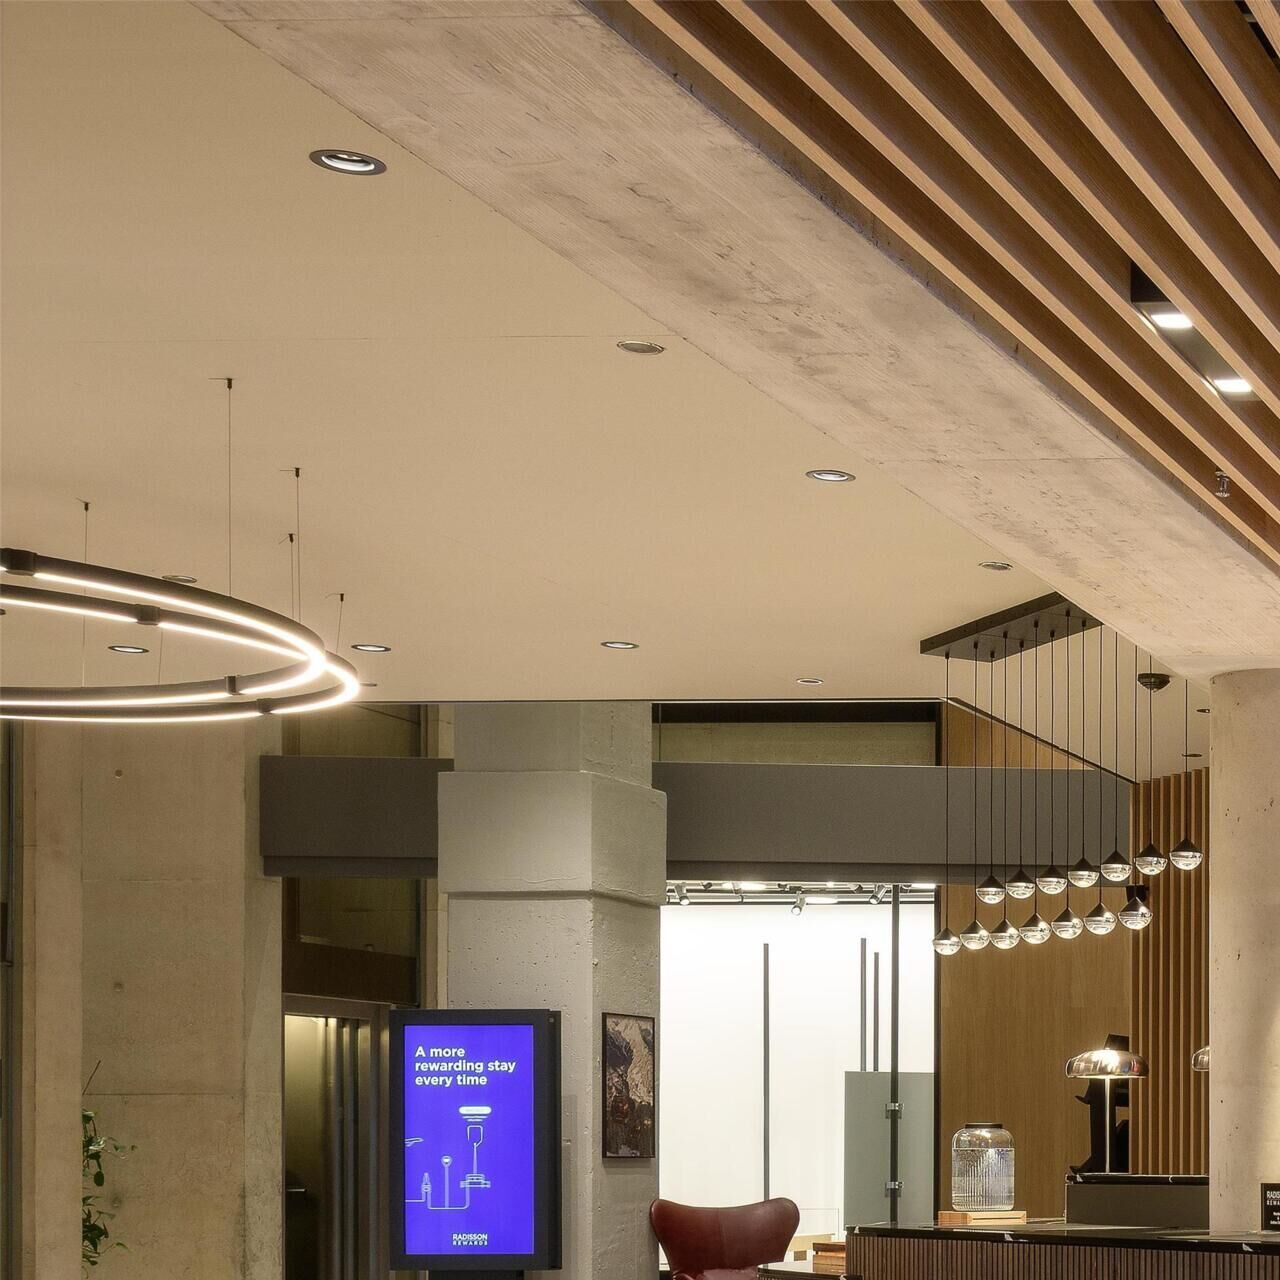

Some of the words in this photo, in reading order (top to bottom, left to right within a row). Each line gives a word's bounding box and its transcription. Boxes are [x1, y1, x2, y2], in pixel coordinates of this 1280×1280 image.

[415, 1046, 426, 1057] A
[430, 1048, 465, 1057] more
[415, 1060, 484, 1073] rewarding
[488, 1060, 516, 1073] stay
[415, 1076, 453, 1087] every
[456, 1074, 487, 1085] time
